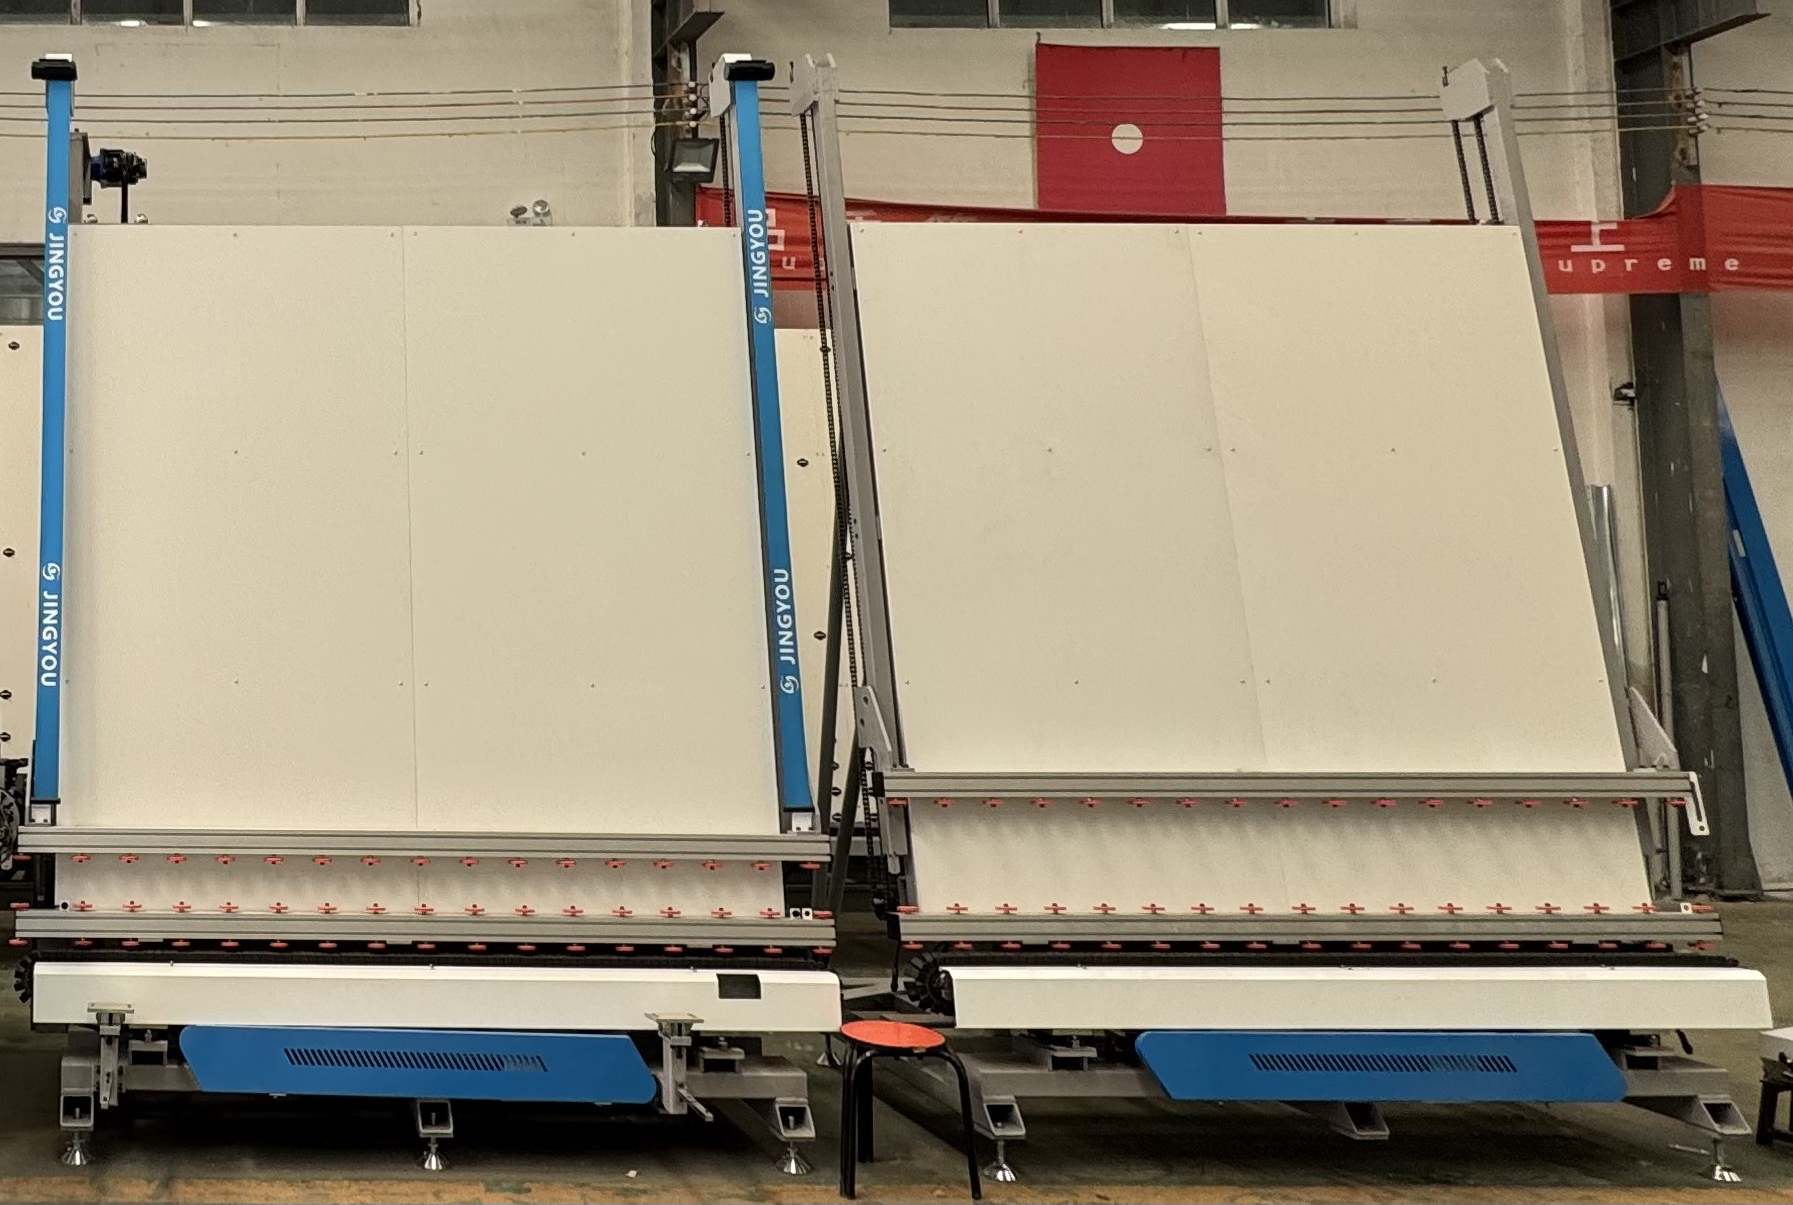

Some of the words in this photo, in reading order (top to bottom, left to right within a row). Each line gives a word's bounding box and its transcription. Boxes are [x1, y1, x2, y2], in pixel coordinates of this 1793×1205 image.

[47, 233, 65, 322] JINGYOU
[747, 209, 769, 298] JINGYOU
[40, 591, 59, 688] JINGYOU
[773, 568, 796, 665] JINGYOU
